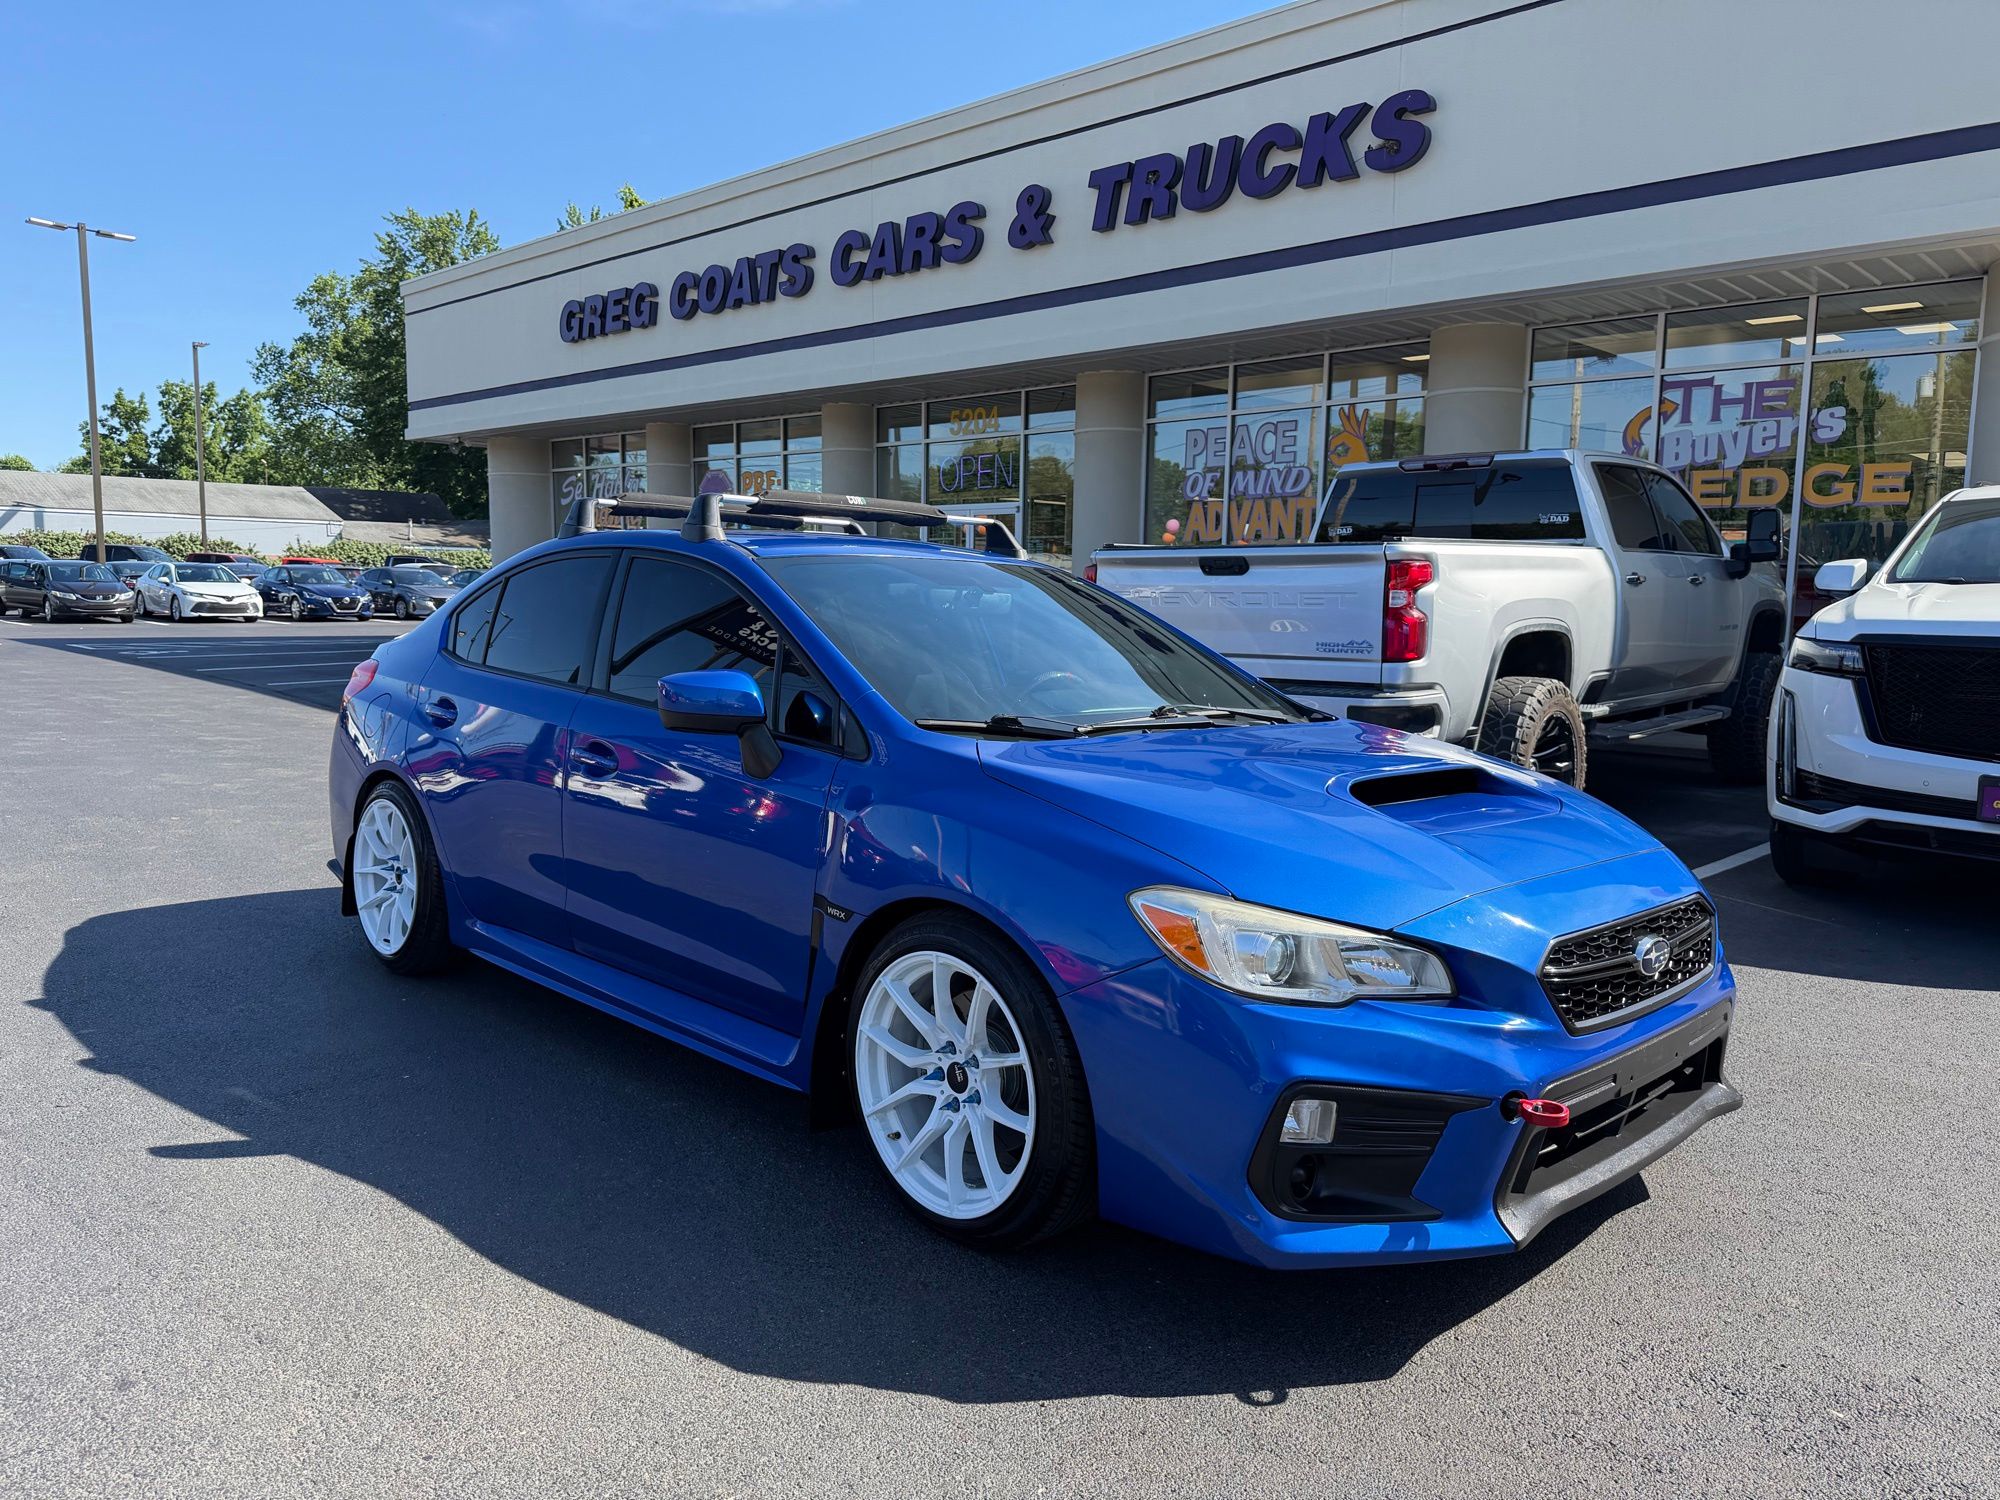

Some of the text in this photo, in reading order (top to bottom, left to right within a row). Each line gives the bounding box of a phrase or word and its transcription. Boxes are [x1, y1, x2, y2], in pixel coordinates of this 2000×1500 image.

[559, 88, 1438, 344] GREG COATS CARS & TRUCKS
[949, 405, 1000, 437] 5204
[1661, 375, 1798, 426] THE
[1184, 419, 1299, 470] PEACE
[1659, 405, 1848, 471] Buyer's
[939, 452, 1013, 493] OPEN
[1183, 465, 1313, 501] OF MIND
[1688, 461, 1913, 511] EDGE
[1182, 496, 1319, 544] ADVANT
[1336, 527, 1353, 535] DAD
[1315, 647, 1375, 655] COUNTRY
[827, 906, 846, 920] WRX
